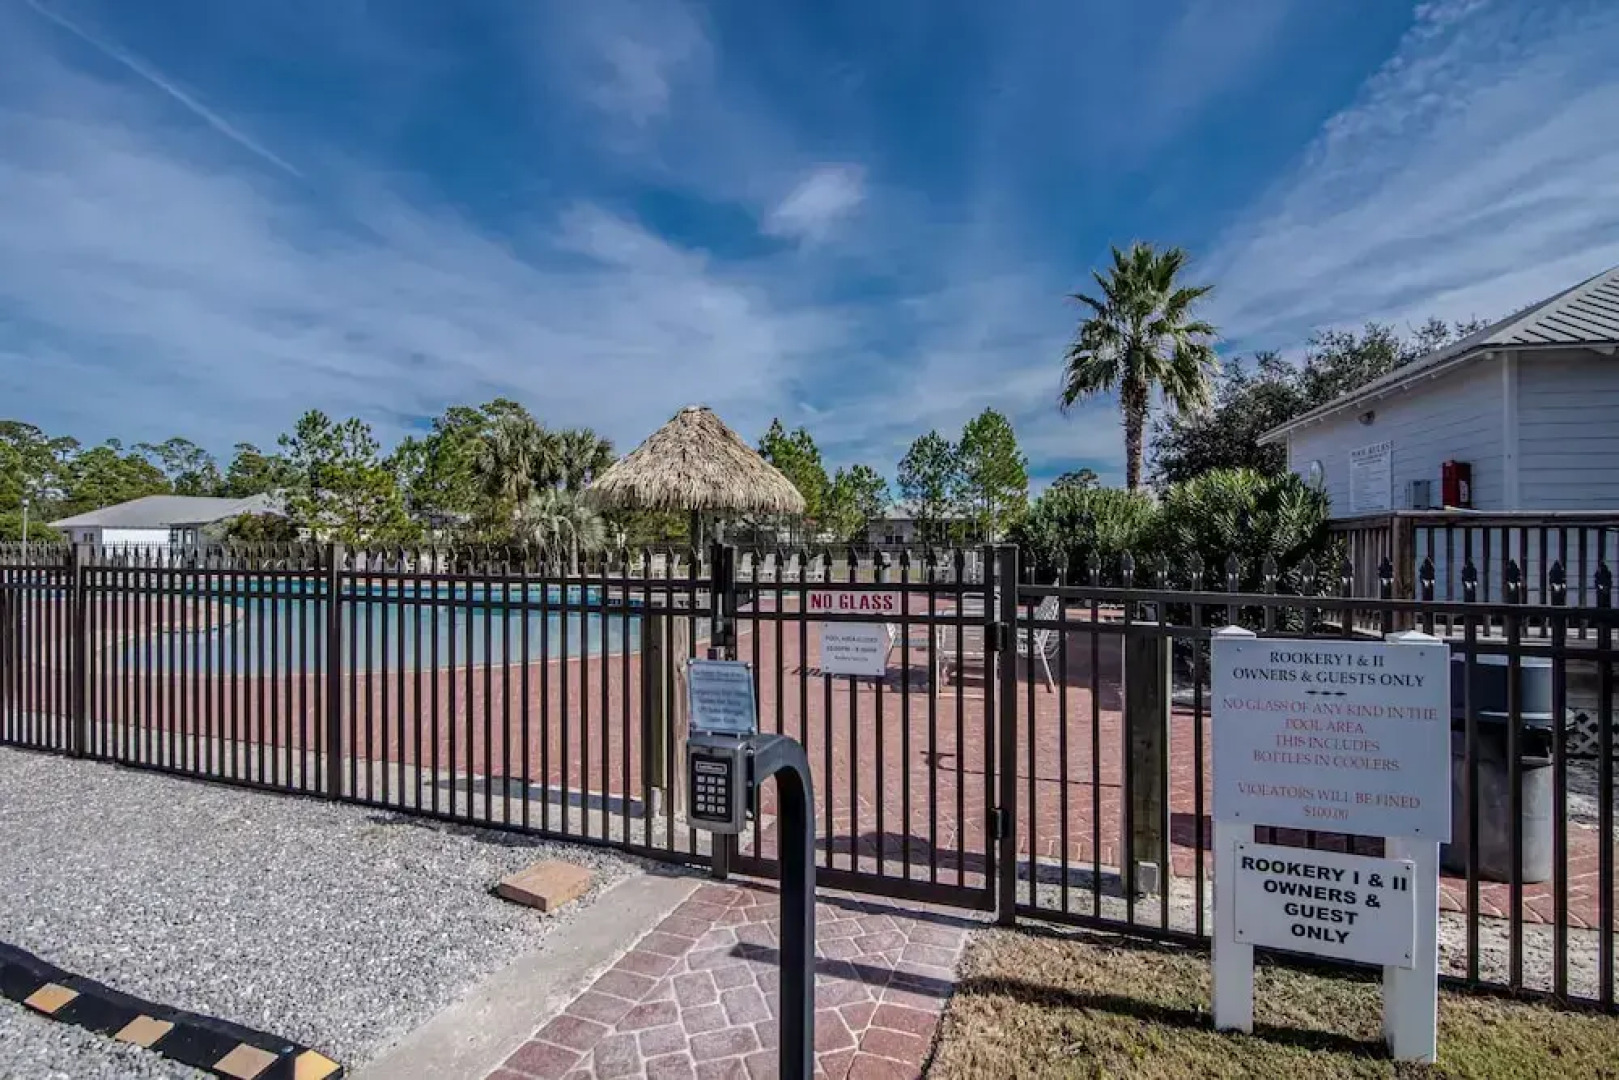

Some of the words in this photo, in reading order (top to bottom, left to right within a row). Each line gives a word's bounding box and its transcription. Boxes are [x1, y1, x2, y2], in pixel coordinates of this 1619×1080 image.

[811, 594, 832, 609] NO
[840, 594, 892, 609] GLASS
[1270, 651, 1343, 666] ROOKERY
[1347, 654, 1352, 666] I
[1357, 654, 1368, 666] &
[1373, 655, 1384, 667] II
[1233, 668, 1297, 682] OWNERS
[1301, 671, 1312, 682] &
[1316, 671, 1376, 685] GUESTS
[1381, 673, 1425, 687] ONLY
[1223, 698, 1244, 710] NO
[1246, 699, 1288, 712] GLASS
[1313, 703, 1344, 715] ANY
[1348, 705, 1383, 717] KIND
[1388, 706, 1403, 719] IN
[1405, 708, 1438, 720] THE
[1276, 734, 1306, 748] THIS
[1309, 737, 1380, 752] INCLUDES
[1254, 749, 1312, 765] BOTTLES
[1315, 754, 1330, 767] IN
[1333, 756, 1400, 771] COOLERS
[1238, 782, 1314, 800] VIOLATORS
[1317, 790, 1348, 802] WILL
[1356, 792, 1372, 804] BE
[1377, 794, 1421, 809] FINED
[1241, 856, 1345, 881] ROOKERY
[1354, 871, 1359, 884] I
[1368, 873, 1384, 888] &
[1393, 876, 1407, 891] II
[1263, 879, 1356, 904] OWNERS
[1365, 894, 1381, 908] &
[1285, 903, 1358, 925] GUEST
[1291, 924, 1350, 944] ONLY
